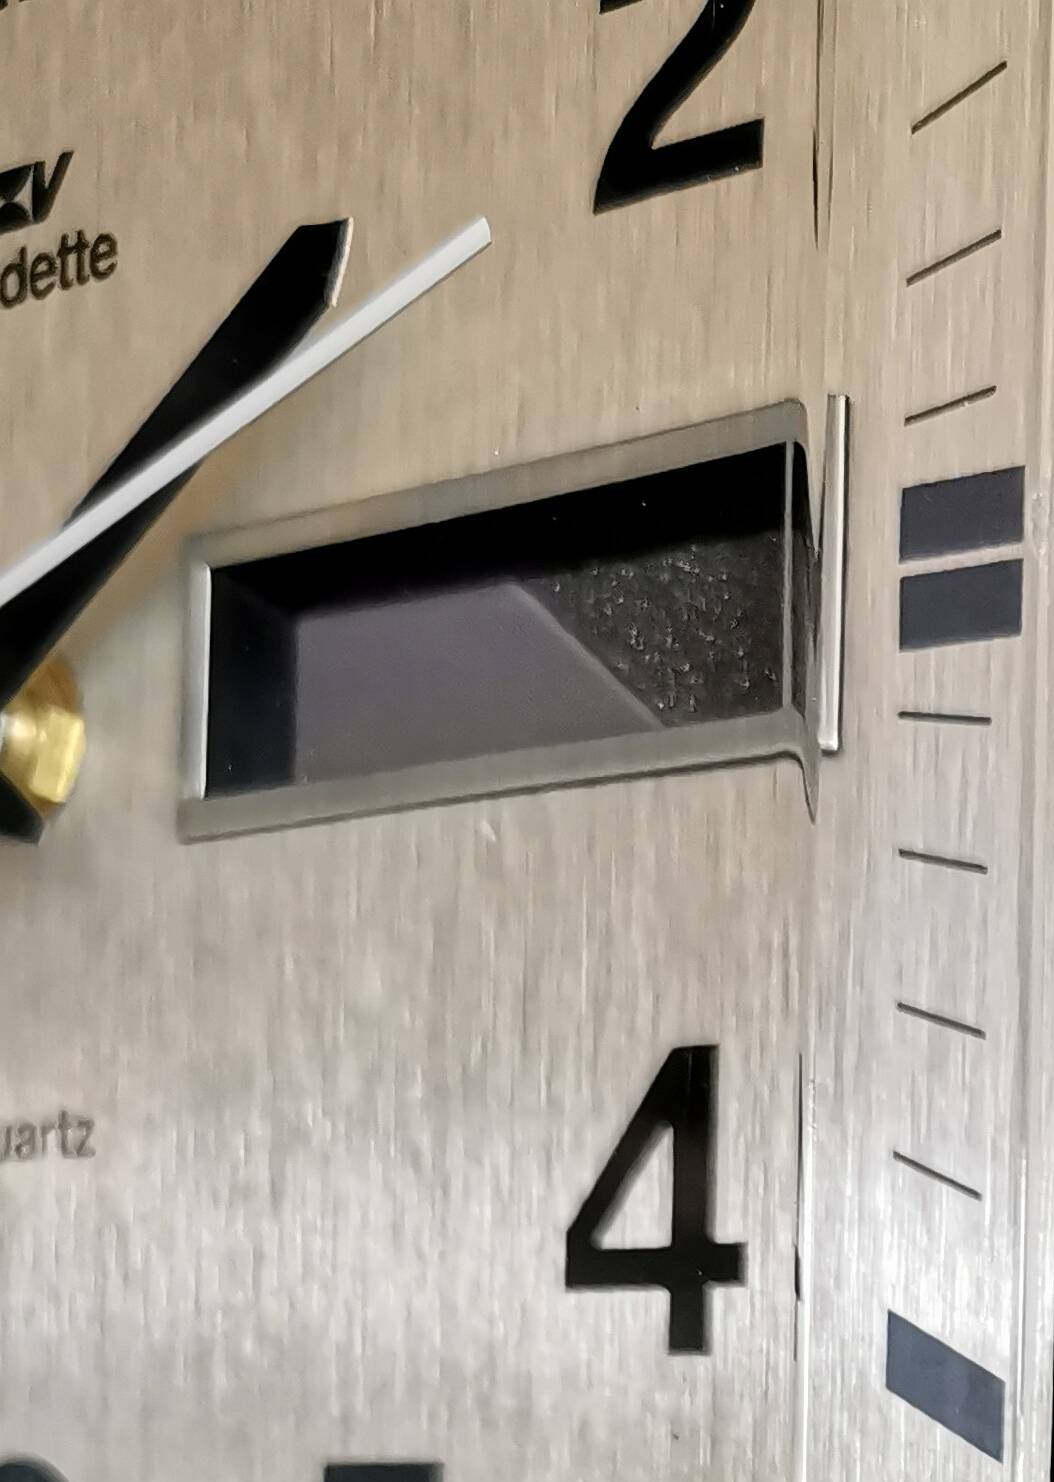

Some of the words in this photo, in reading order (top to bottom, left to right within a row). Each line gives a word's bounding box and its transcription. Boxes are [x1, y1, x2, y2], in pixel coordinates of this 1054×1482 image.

[593, 0, 765, 216] 2
[0, 229, 119, 309] dette
[565, 1044, 748, 1356] 4
